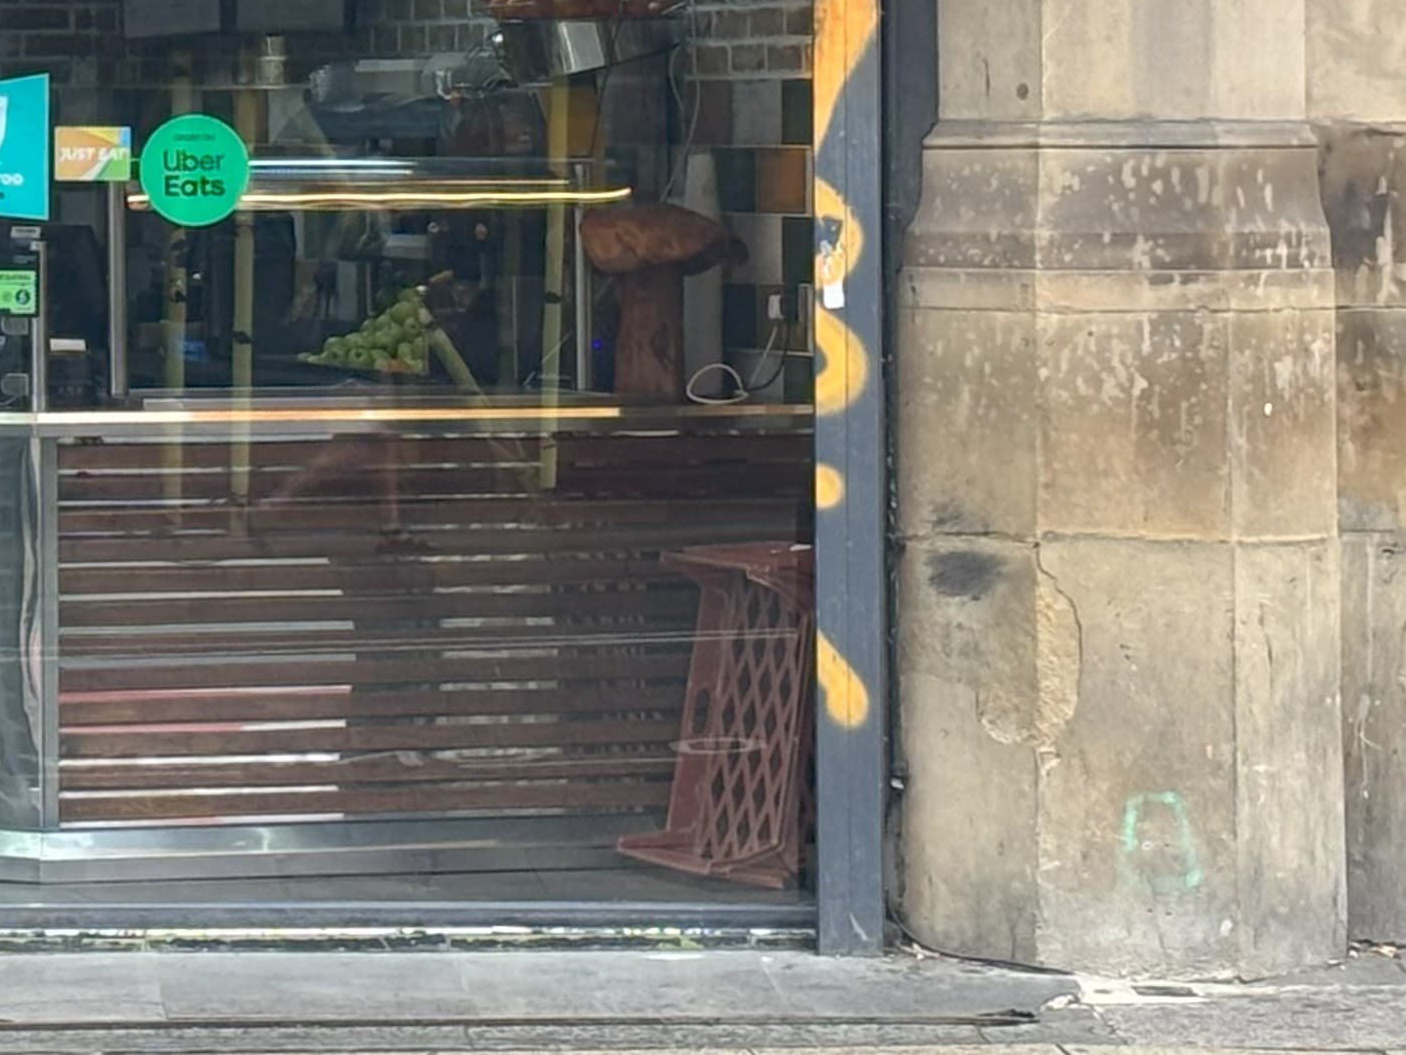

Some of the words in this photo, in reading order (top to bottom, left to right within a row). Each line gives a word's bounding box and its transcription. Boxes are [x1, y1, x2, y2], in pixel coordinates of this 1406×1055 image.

[58, 147, 95, 162] JUST
[98, 146, 128, 162] EAT
[163, 149, 225, 171] Uber
[164, 175, 226, 197] Eats
